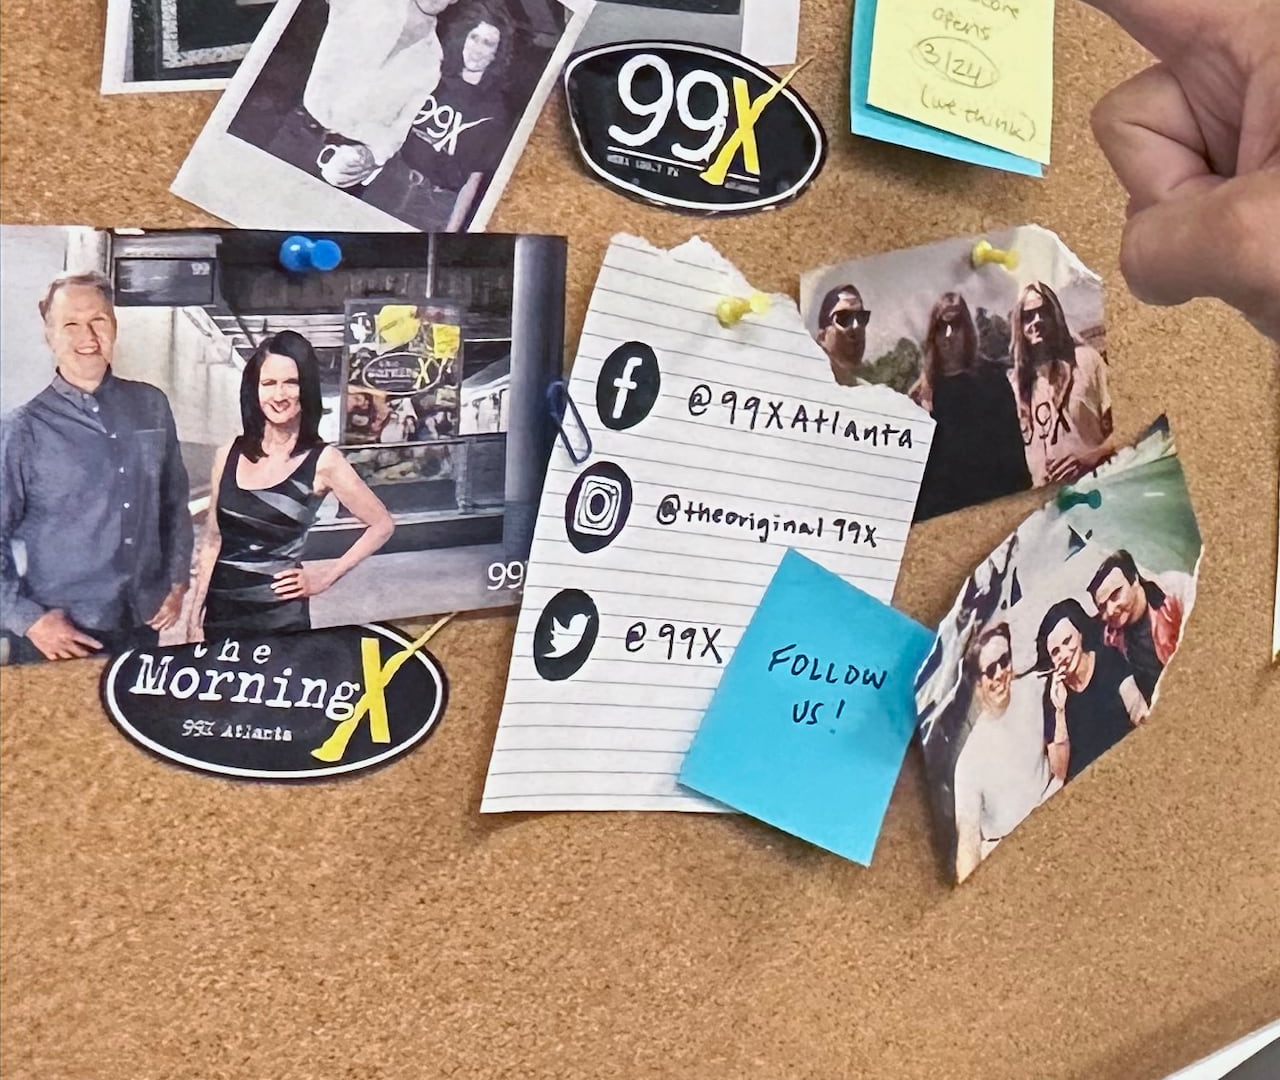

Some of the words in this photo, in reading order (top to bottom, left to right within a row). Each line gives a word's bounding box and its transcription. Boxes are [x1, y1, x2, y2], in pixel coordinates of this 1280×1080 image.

[607, 54, 800, 186] 99X
[487, 561, 527, 594] 99
[767, 642, 889, 692] FOLLOW
[791, 697, 846, 735] US!
